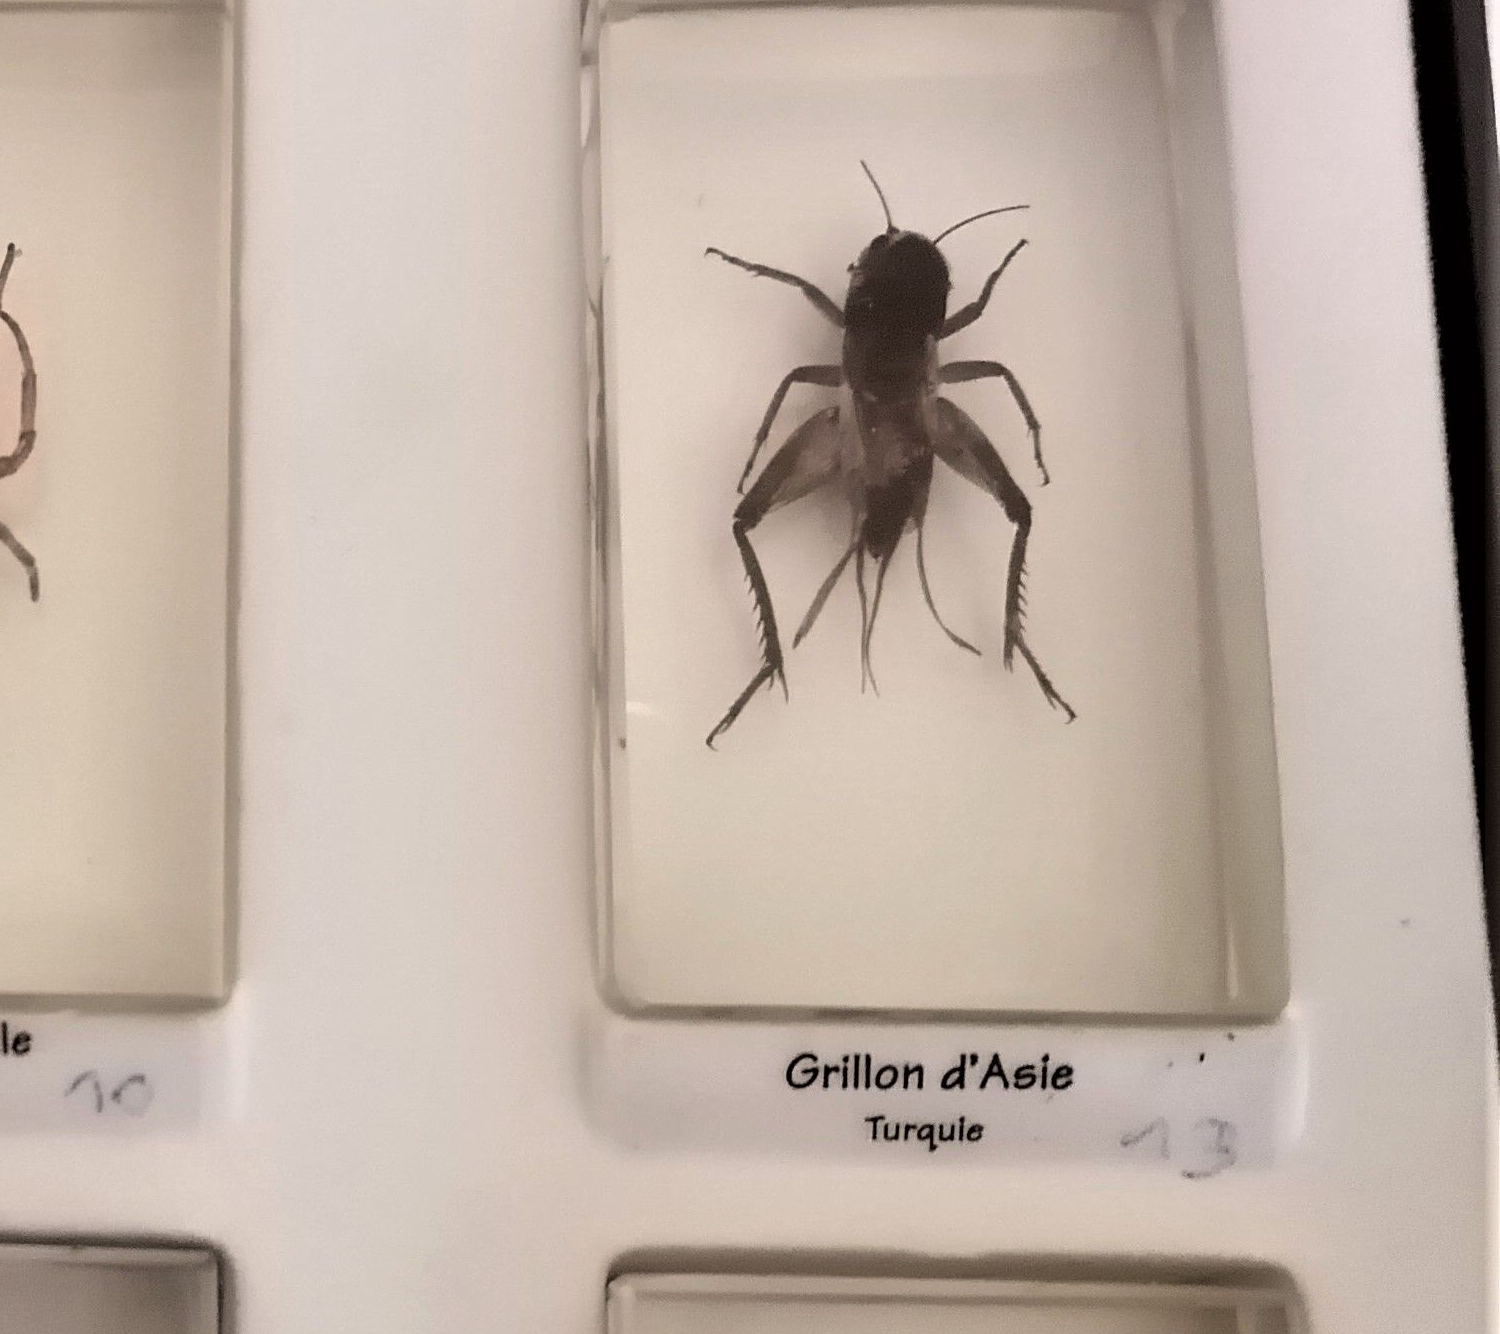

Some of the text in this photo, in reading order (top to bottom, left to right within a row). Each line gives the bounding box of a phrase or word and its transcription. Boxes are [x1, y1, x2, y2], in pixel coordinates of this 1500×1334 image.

[64, 1069, 153, 1116] 10
[786, 1053, 1075, 1091] Grillon d'Asie
[864, 1115, 984, 1152] Turquie
[1119, 1116, 1238, 1179] 13
